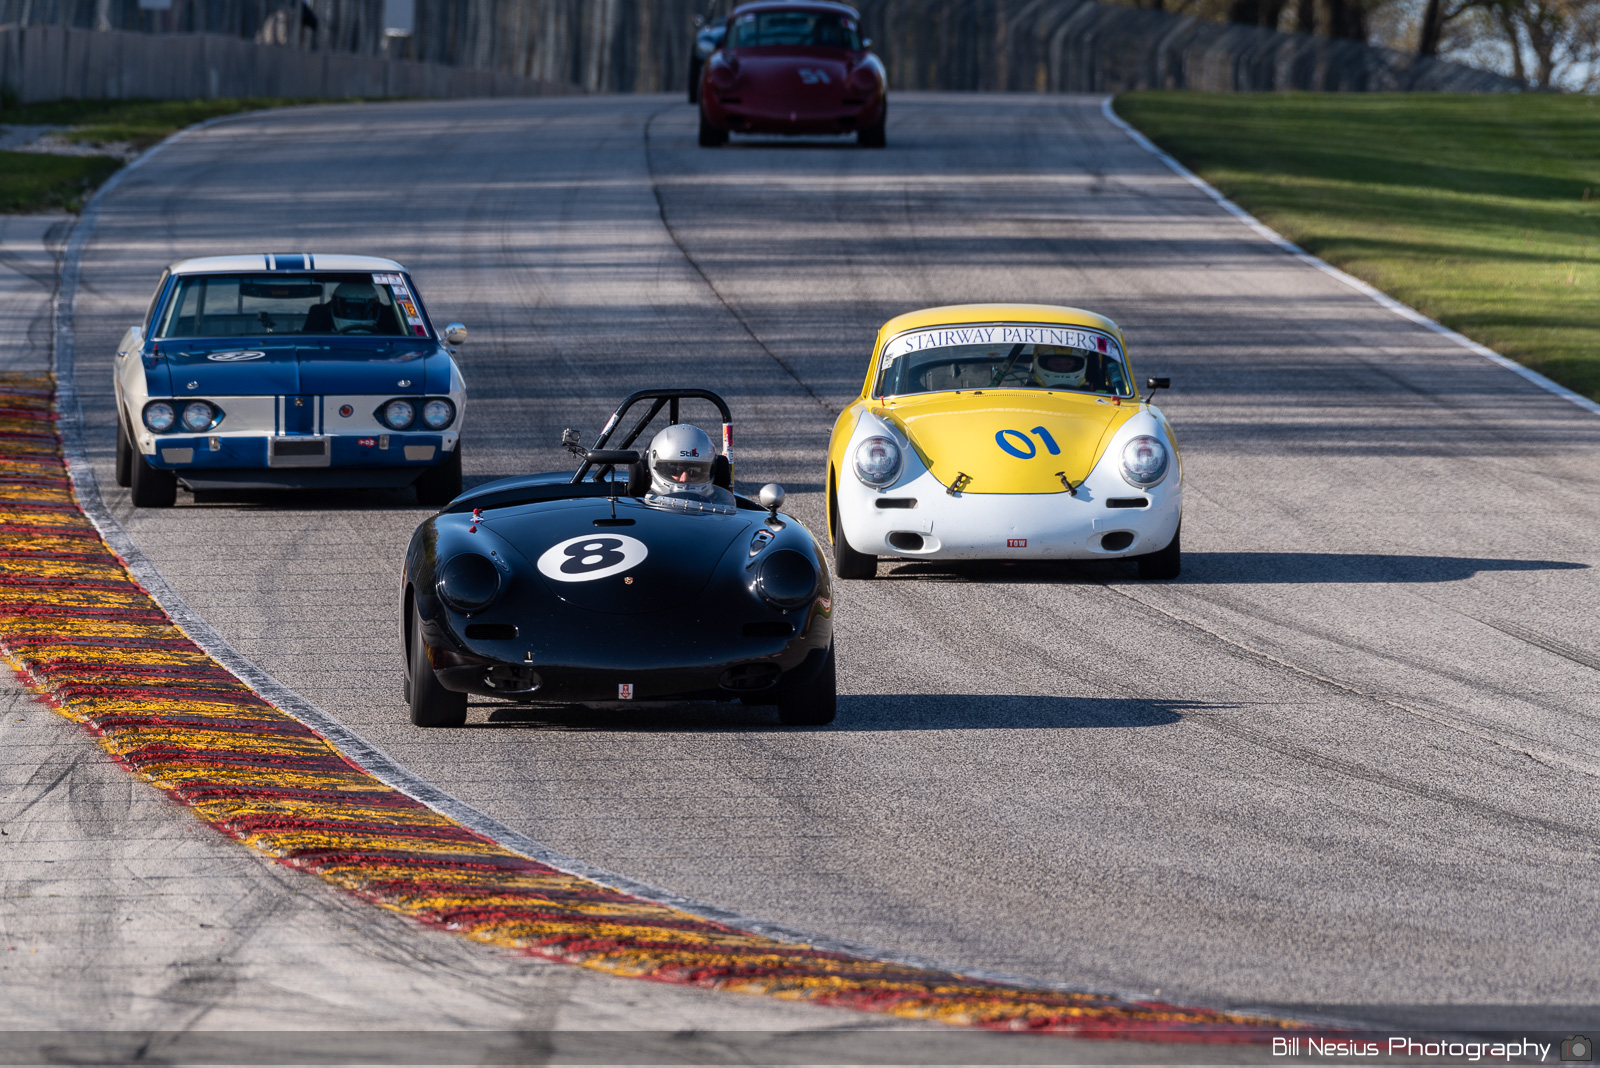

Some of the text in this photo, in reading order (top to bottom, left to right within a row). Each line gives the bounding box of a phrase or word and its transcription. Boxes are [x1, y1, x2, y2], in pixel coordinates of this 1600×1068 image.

[905, 328, 1097, 353] STAIRWAY PARTNERS
[995, 425, 1061, 460] 01
[560, 538, 625, 574] 8
